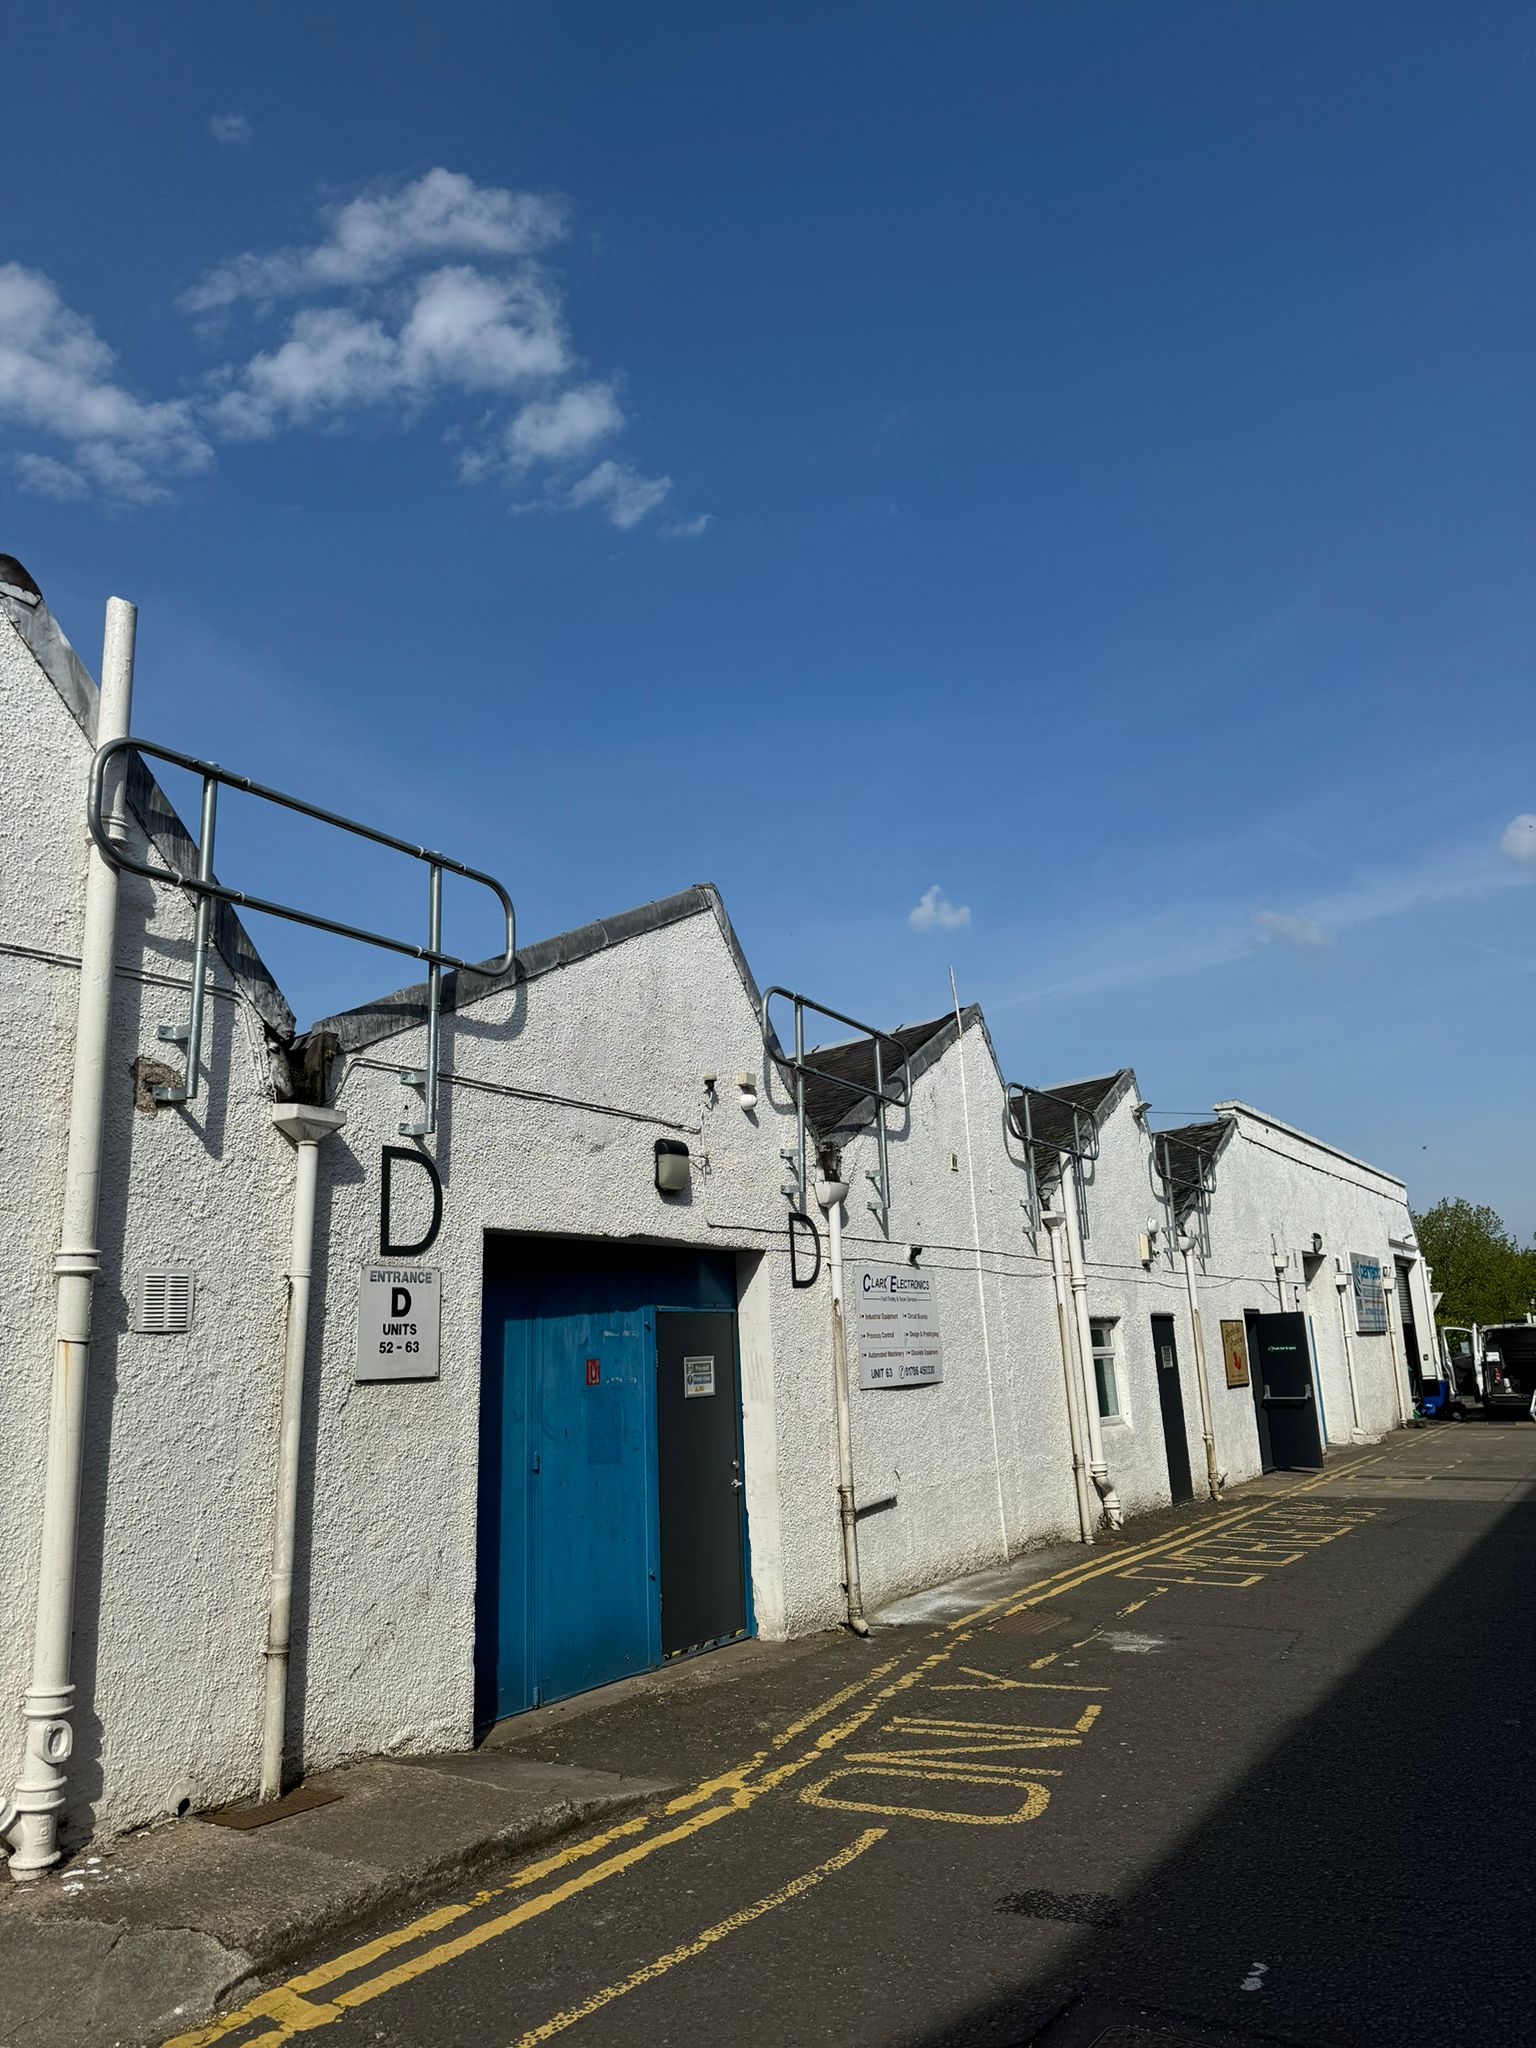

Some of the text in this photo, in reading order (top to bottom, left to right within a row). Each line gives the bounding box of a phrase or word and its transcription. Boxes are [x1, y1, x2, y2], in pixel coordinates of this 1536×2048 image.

[380, 1145, 443, 1256] D
[788, 1212, 821, 1289] D
[369, 1270, 433, 1284] ENTRANCE
[890, 1275, 930, 1293] ELECTRONICS
[391, 1286, 412, 1318] D
[382, 1323, 417, 1336] UNITS
[379, 1341, 394, 1354] 52
[405, 1340, 420, 1353] 63
[871, 1368, 884, 1379] UNIT
[885, 1367, 893, 1378] 63
[799, 1667, 1111, 1825] ONLY
